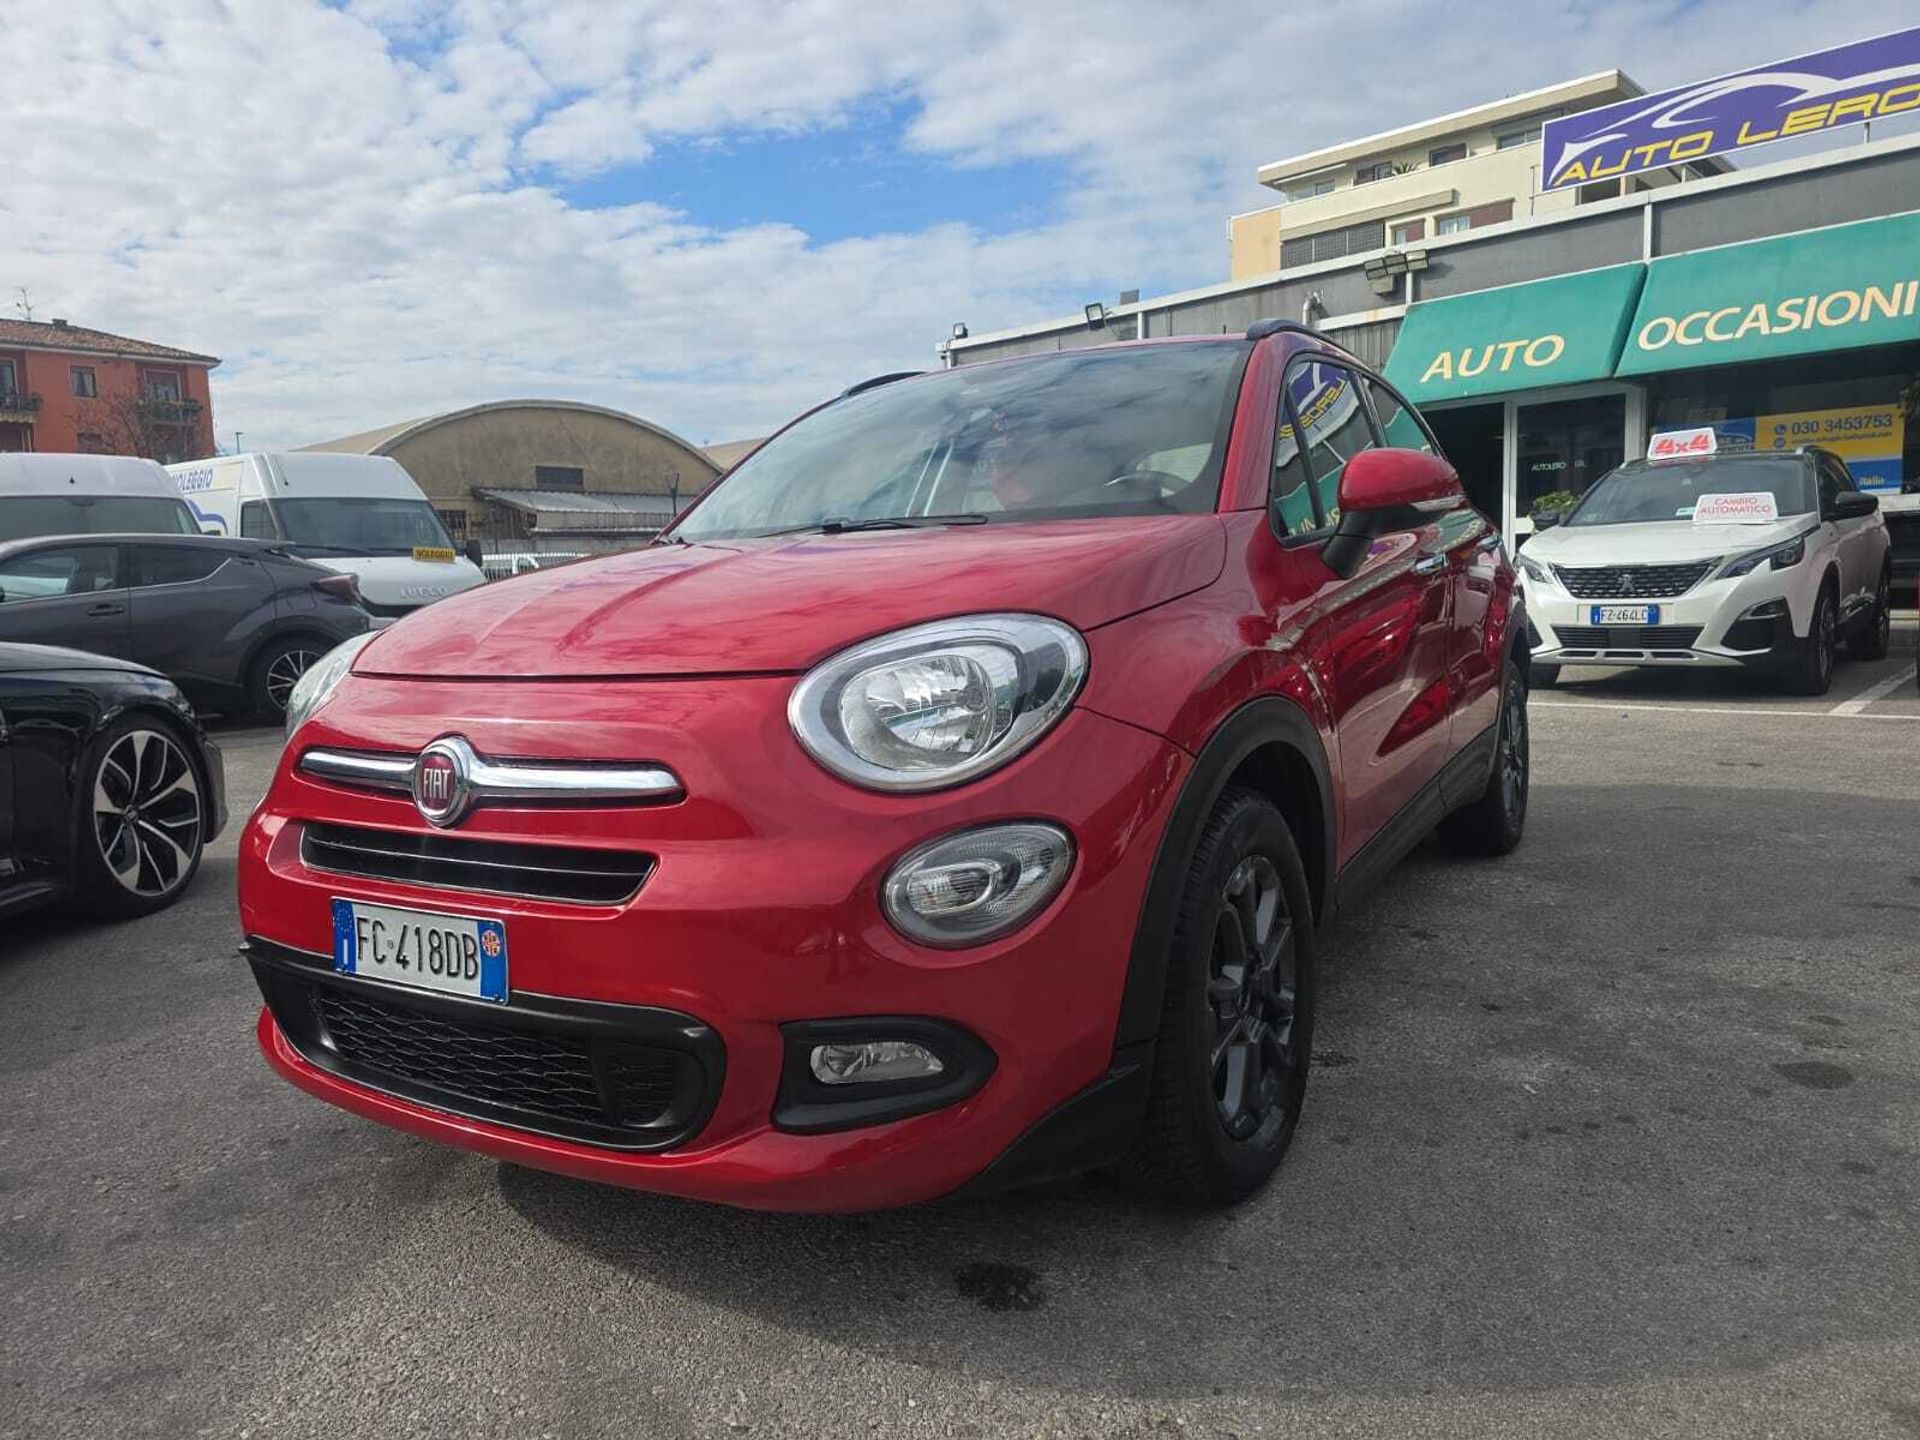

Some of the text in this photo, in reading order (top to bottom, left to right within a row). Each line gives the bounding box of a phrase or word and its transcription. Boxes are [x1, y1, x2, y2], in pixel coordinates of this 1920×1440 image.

[1553, 130, 1714, 187] AUTO
[1419, 281, 1918, 383] AUTO OCCASIONI
[1791, 414, 1893, 434] 030 3453753
[1655, 433, 1709, 454] 4x4
[1701, 504, 1771, 515] AUTOMATICO
[1714, 497, 1758, 506] CAMBIO
[423, 767, 451, 800] FIAT
